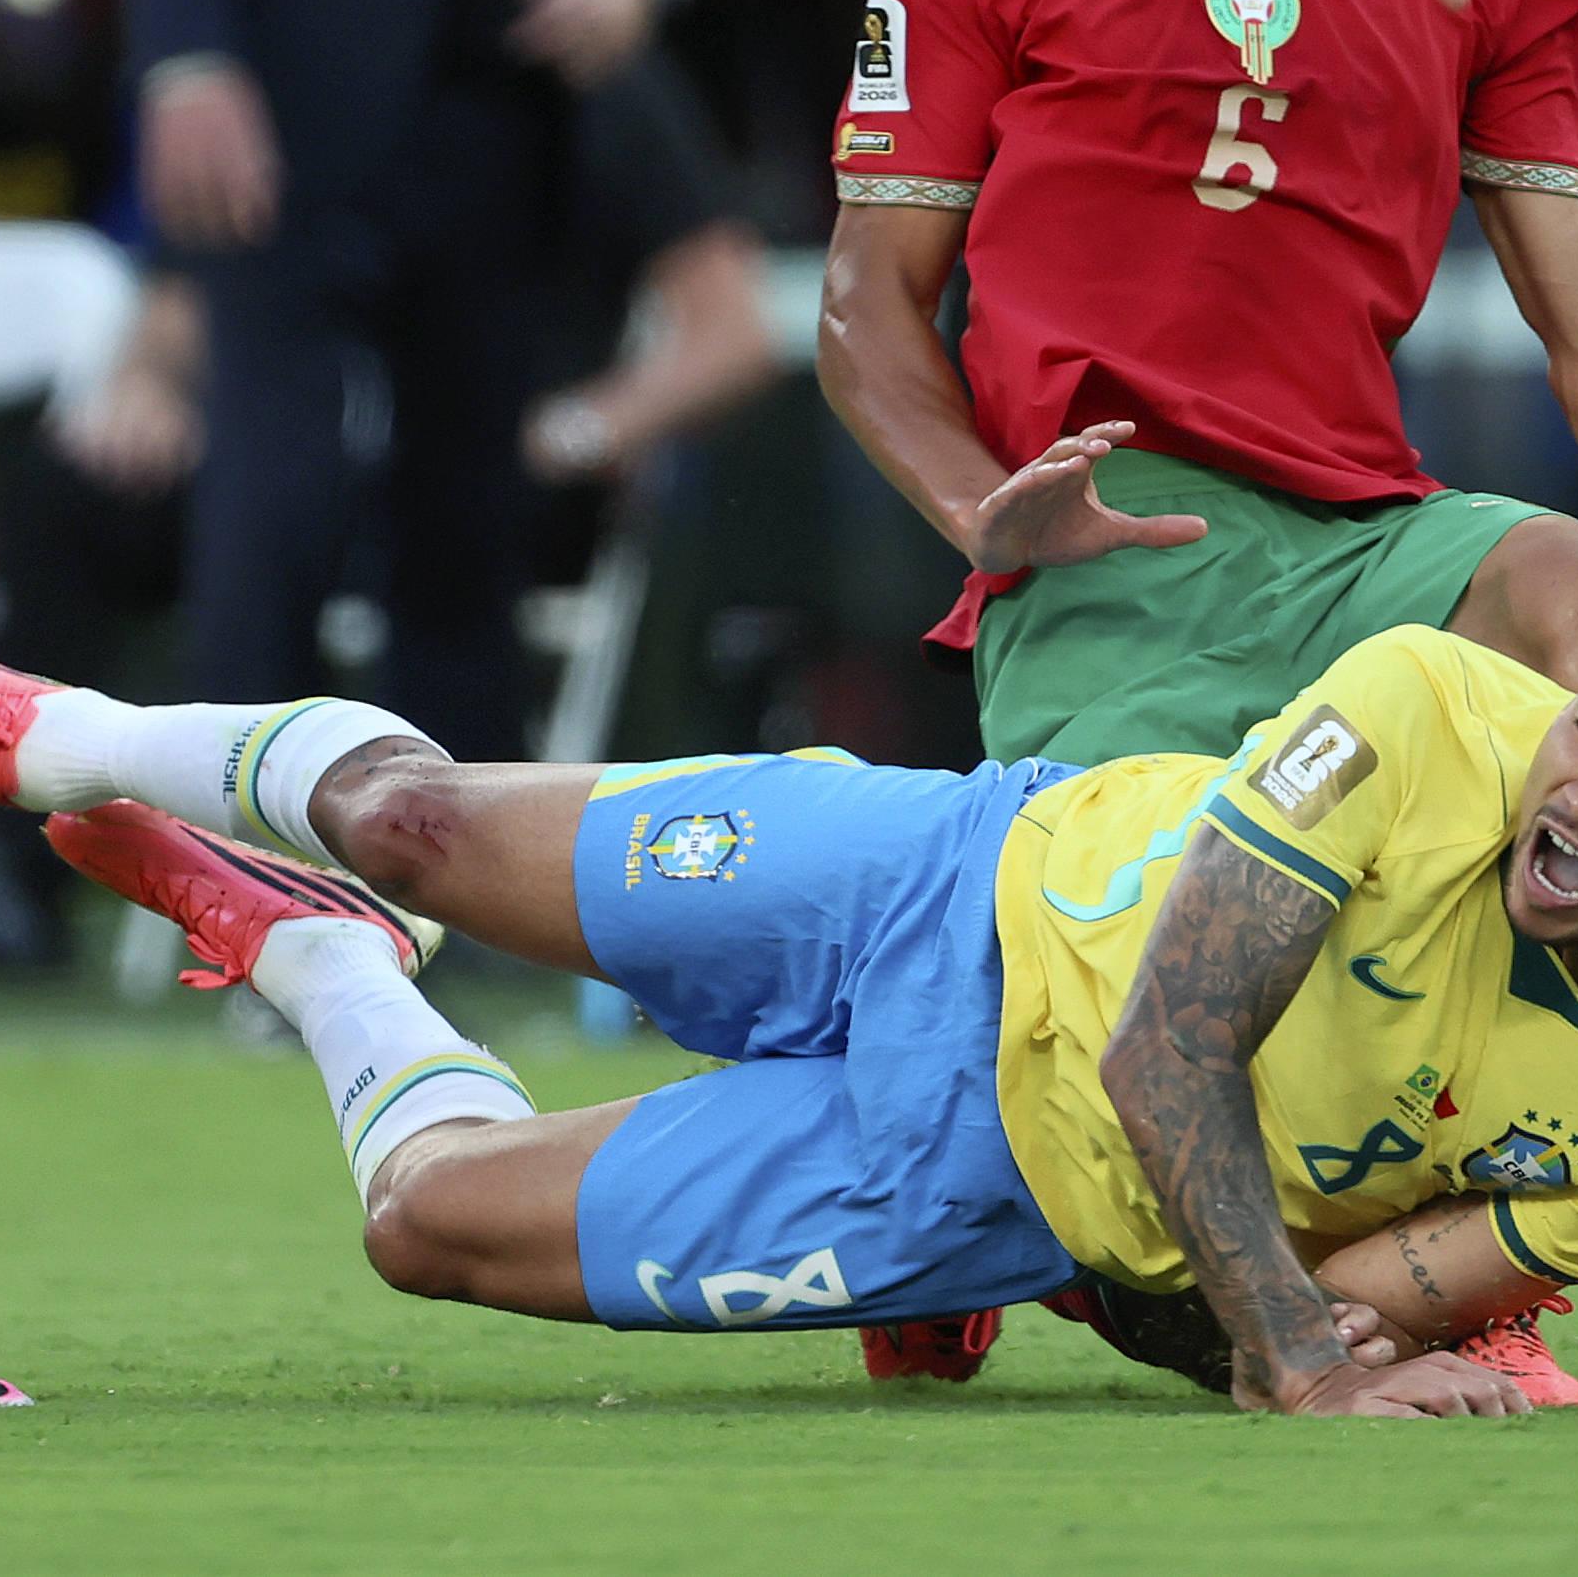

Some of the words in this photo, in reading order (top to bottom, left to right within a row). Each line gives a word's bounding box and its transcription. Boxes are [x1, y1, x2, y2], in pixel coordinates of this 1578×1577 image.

[858, 91, 898, 101] 2026
[1191, 83, 1291, 213] 6
[625, 813, 652, 891] BRASIL
[1297, 1119, 1425, 1195] 8
[698, 1246, 854, 1326] 8
